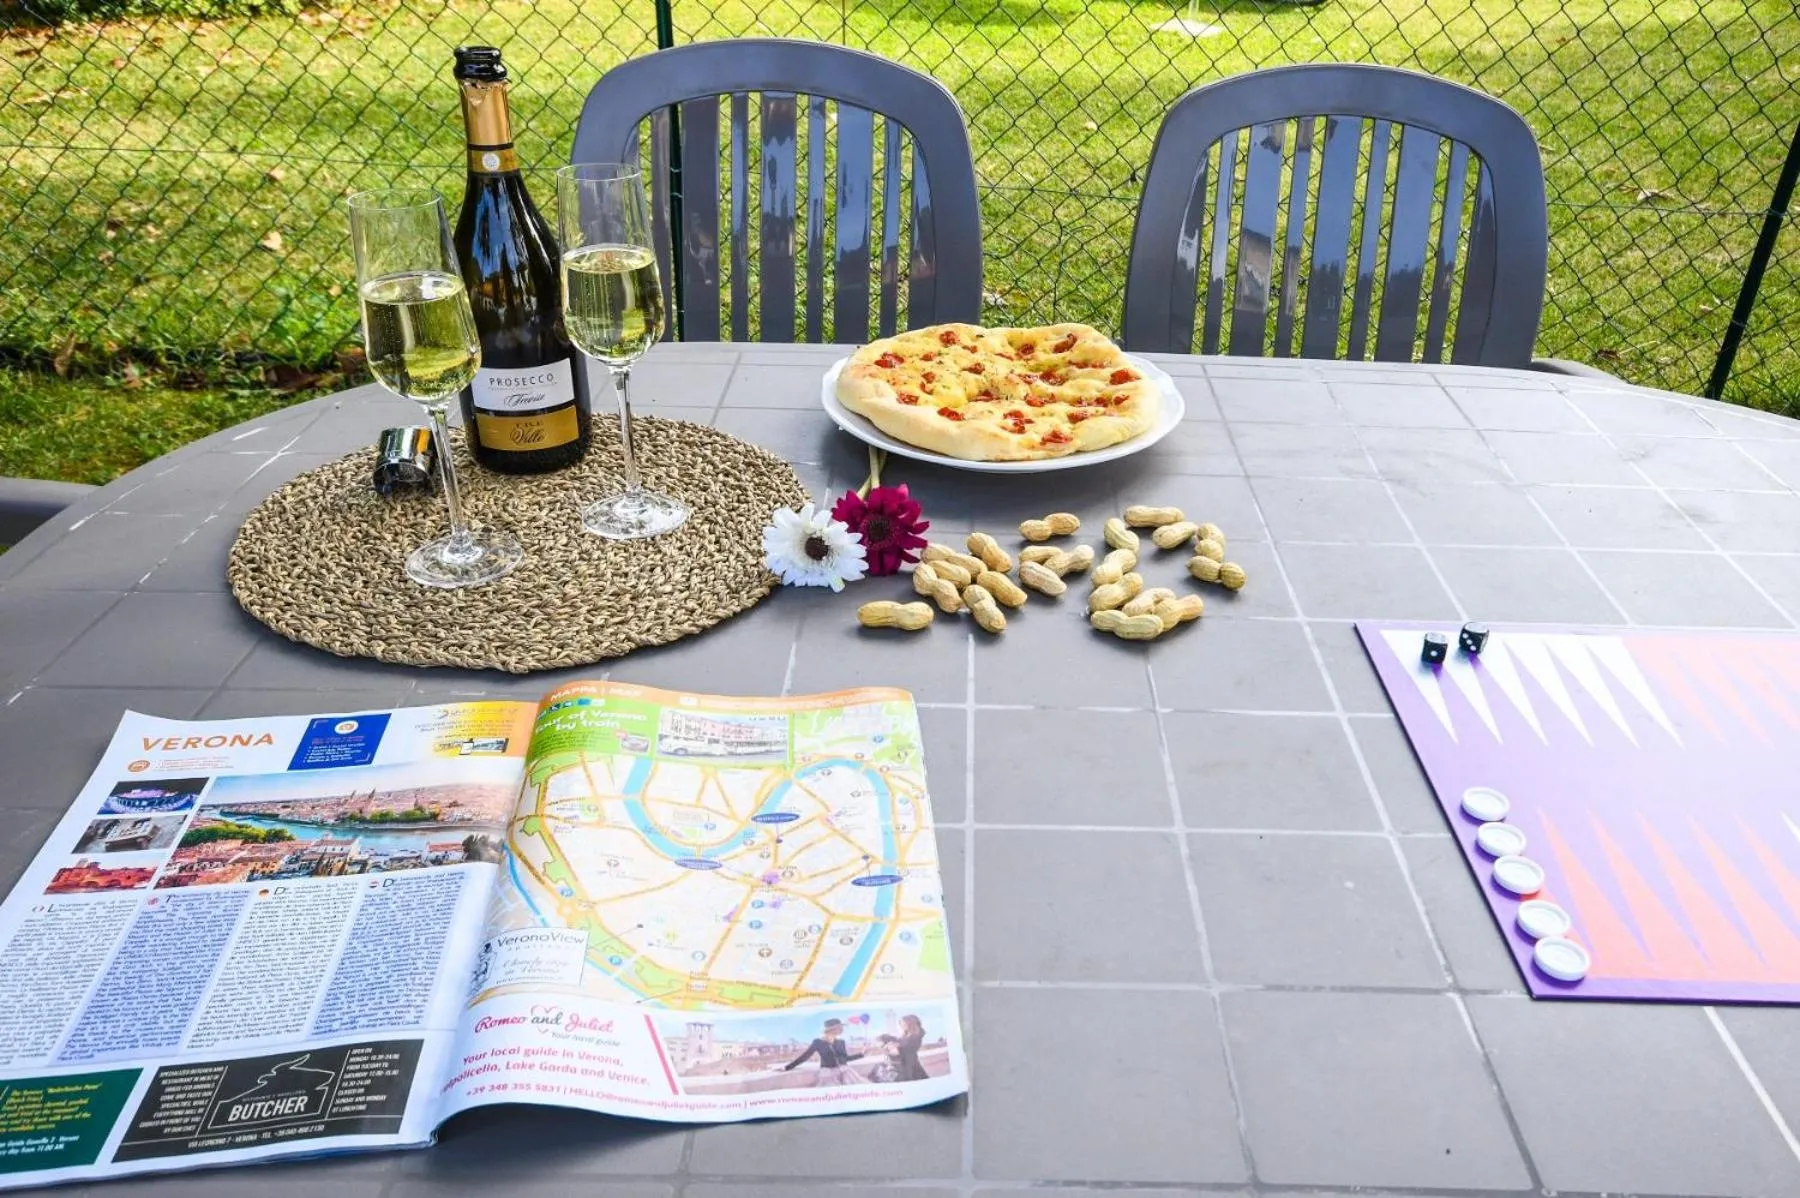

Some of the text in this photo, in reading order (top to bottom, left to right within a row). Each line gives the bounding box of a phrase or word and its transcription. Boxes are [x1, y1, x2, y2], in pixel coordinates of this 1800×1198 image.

[489, 373, 554, 387] PROSECCO
[591, 710, 647, 721] Verona
[142, 733, 275, 751] VERONA
[474, 1011, 614, 1034] Romeo and Juliet
[463, 1052, 488, 1065] Your
[490, 1046, 521, 1057] local
[524, 1047, 558, 1058] guide
[578, 1050, 624, 1067] Verona,
[505, 1060, 536, 1070] Lake
[539, 1061, 577, 1075] Garda
[580, 1067, 606, 1078] and
[608, 1069, 651, 1086] Venice.
[227, 1096, 309, 1122] BUTCHER
